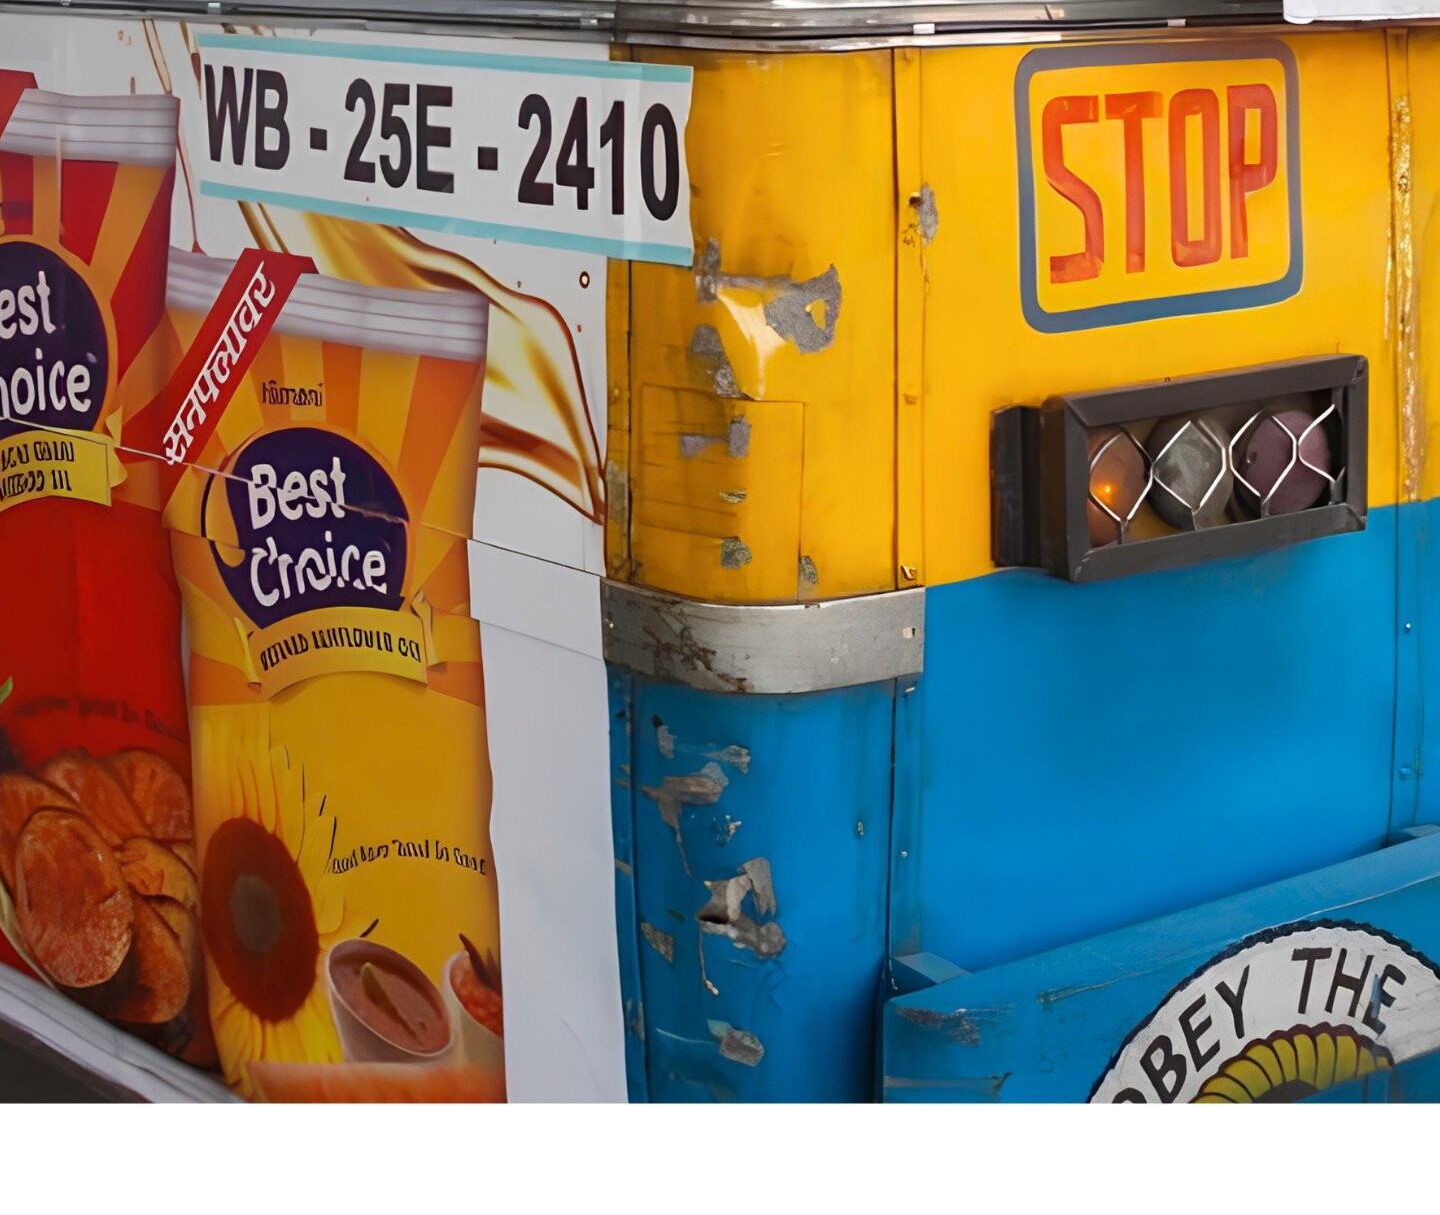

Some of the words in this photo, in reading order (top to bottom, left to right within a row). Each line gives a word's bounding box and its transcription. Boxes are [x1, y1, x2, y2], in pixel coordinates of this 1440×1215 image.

[204, 64, 290, 171] WB
[343, 77, 455, 194] 25E
[517, 93, 680, 222] 2410
[1041, 83, 1279, 285] STOP
[250, 457, 346, 530] Best
[1291, 948, 1406, 1038] THE
